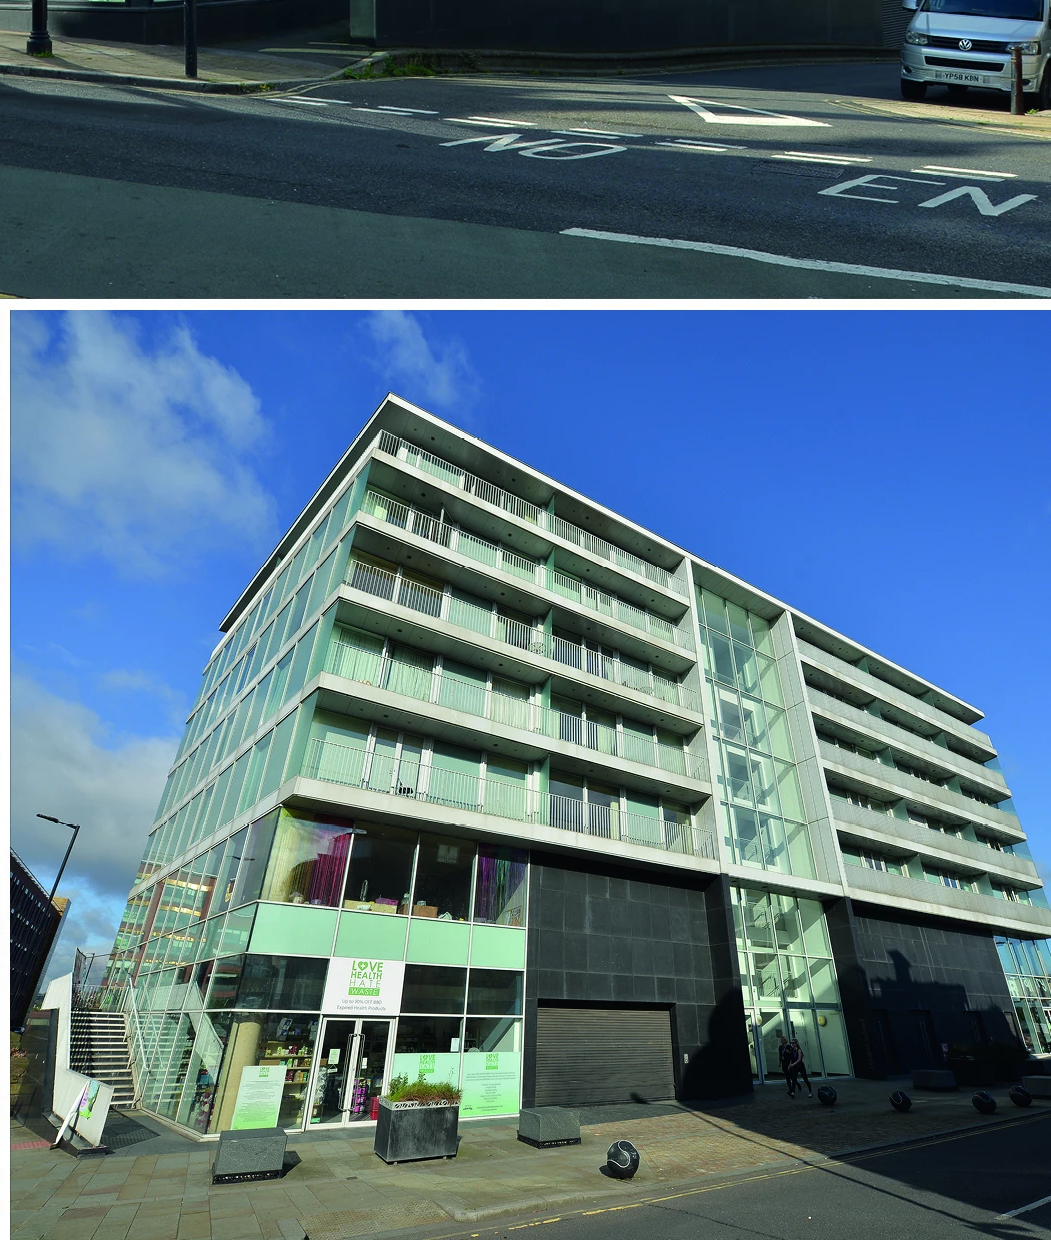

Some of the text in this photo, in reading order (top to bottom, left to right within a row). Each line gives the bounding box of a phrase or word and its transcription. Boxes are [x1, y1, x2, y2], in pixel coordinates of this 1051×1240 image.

[439, 133, 627, 160] NO
[352, 960, 384, 972] LOVE
[350, 971, 383, 980] HEALTH
[351, 988, 378, 996] WASTE
